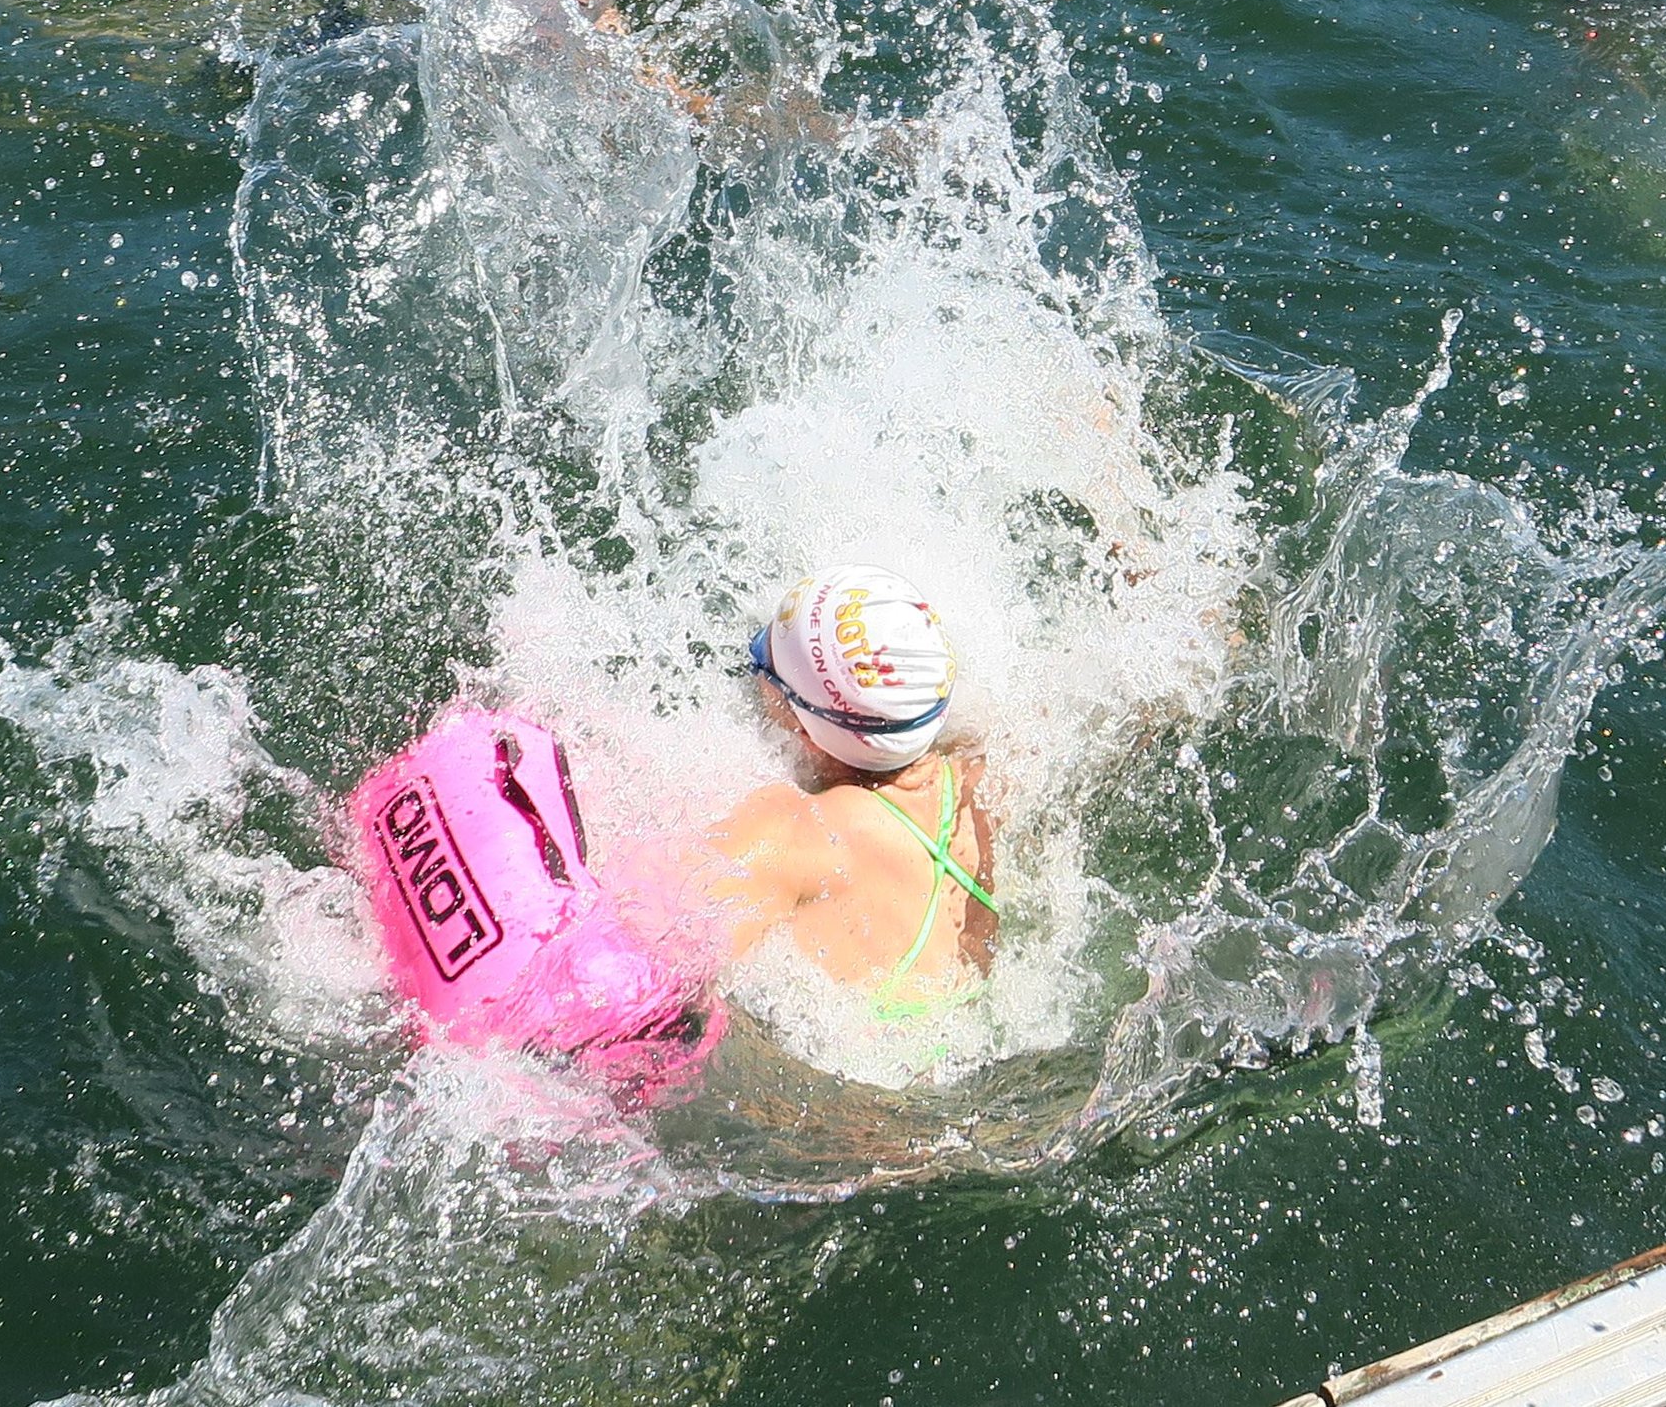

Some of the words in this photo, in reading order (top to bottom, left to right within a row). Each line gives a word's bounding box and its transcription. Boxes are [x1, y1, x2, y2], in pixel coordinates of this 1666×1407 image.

[809, 584, 832, 630] NAGE
[834, 588, 874, 660] FSGT
[808, 632, 827, 673] TON
[384, 789, 488, 964] LOMO
